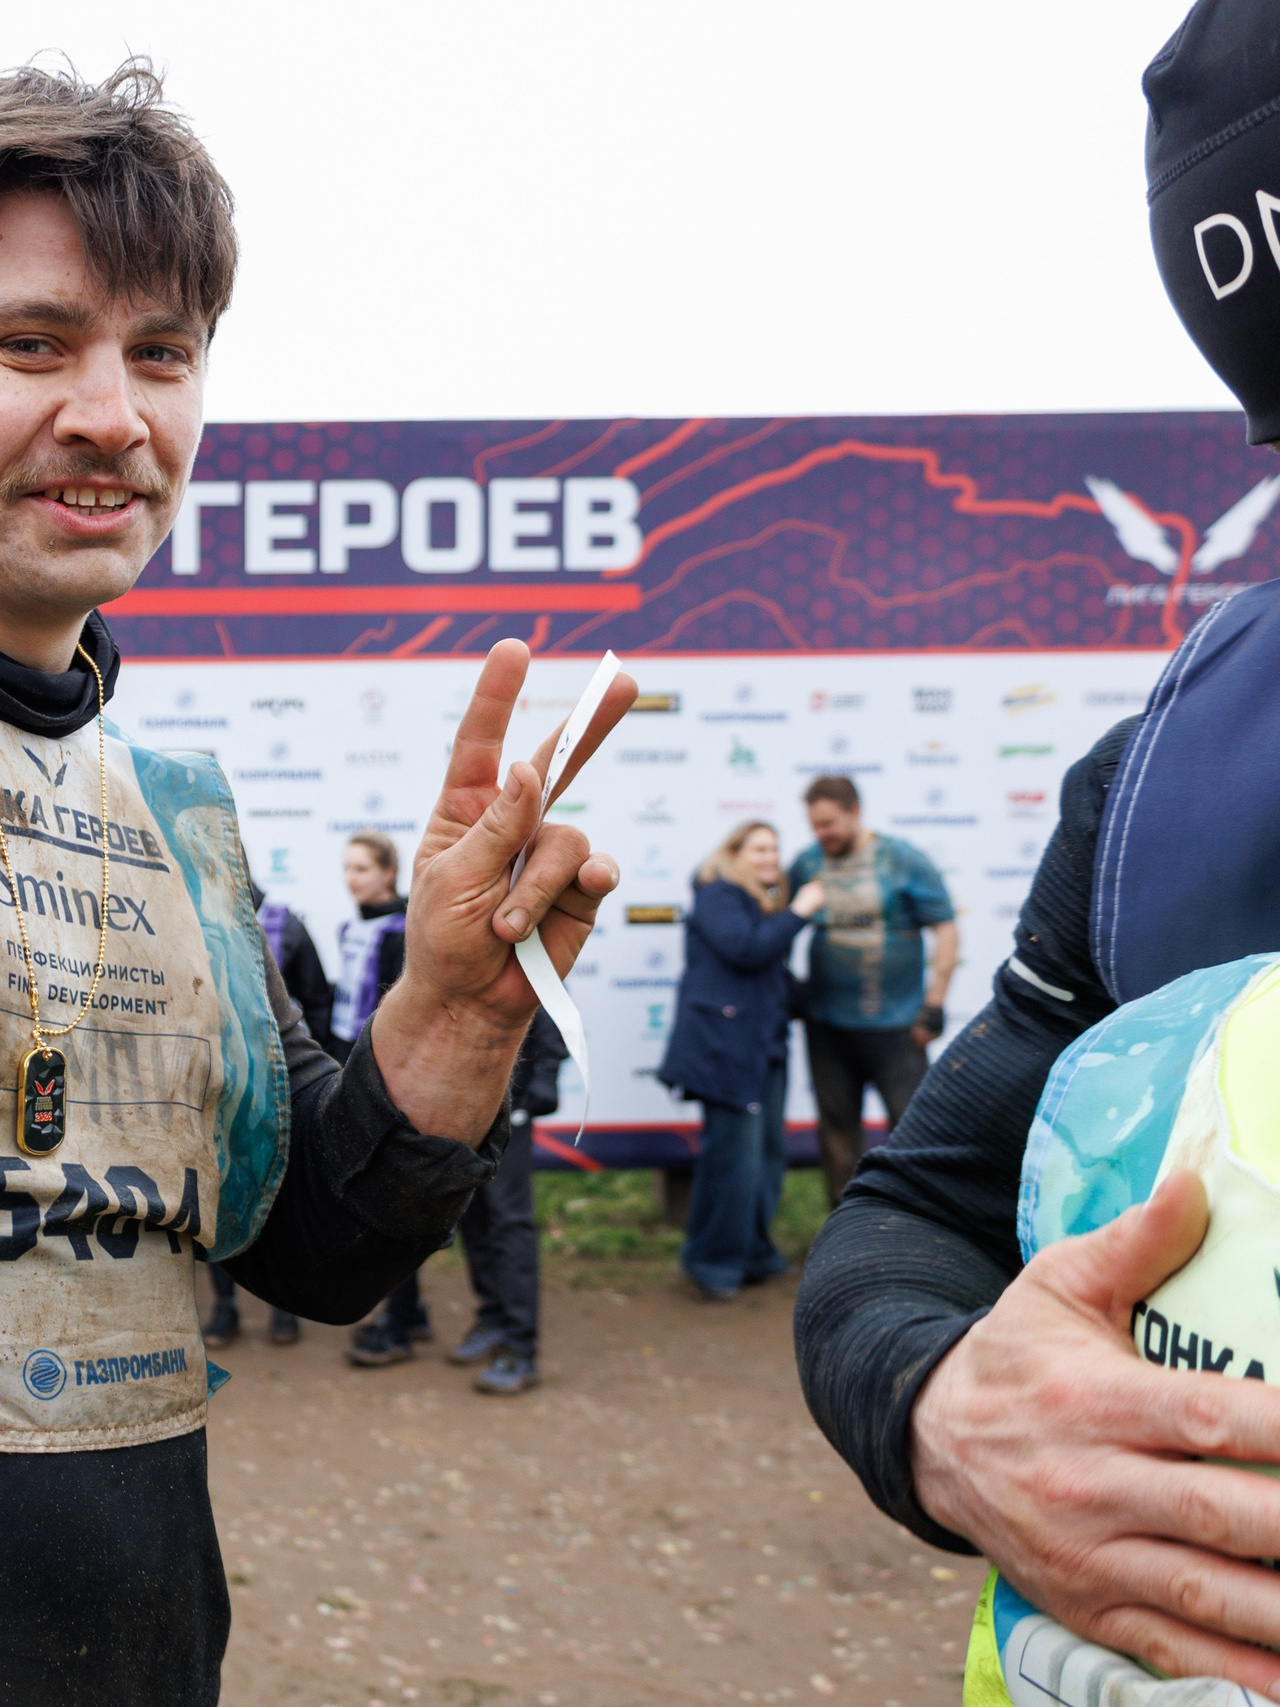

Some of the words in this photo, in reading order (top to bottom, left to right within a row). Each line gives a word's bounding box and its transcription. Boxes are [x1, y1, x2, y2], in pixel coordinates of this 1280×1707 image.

[170, 475, 643, 575] ГЕРОЕВ
[53, 803, 164, 860] ГЕРОЕВ
[8, 972, 39, 998] FIN
[48, 983, 168, 1016] DEVELOPMENT
[74, 1347, 188, 1387] ГАЗПРОМБАНК
